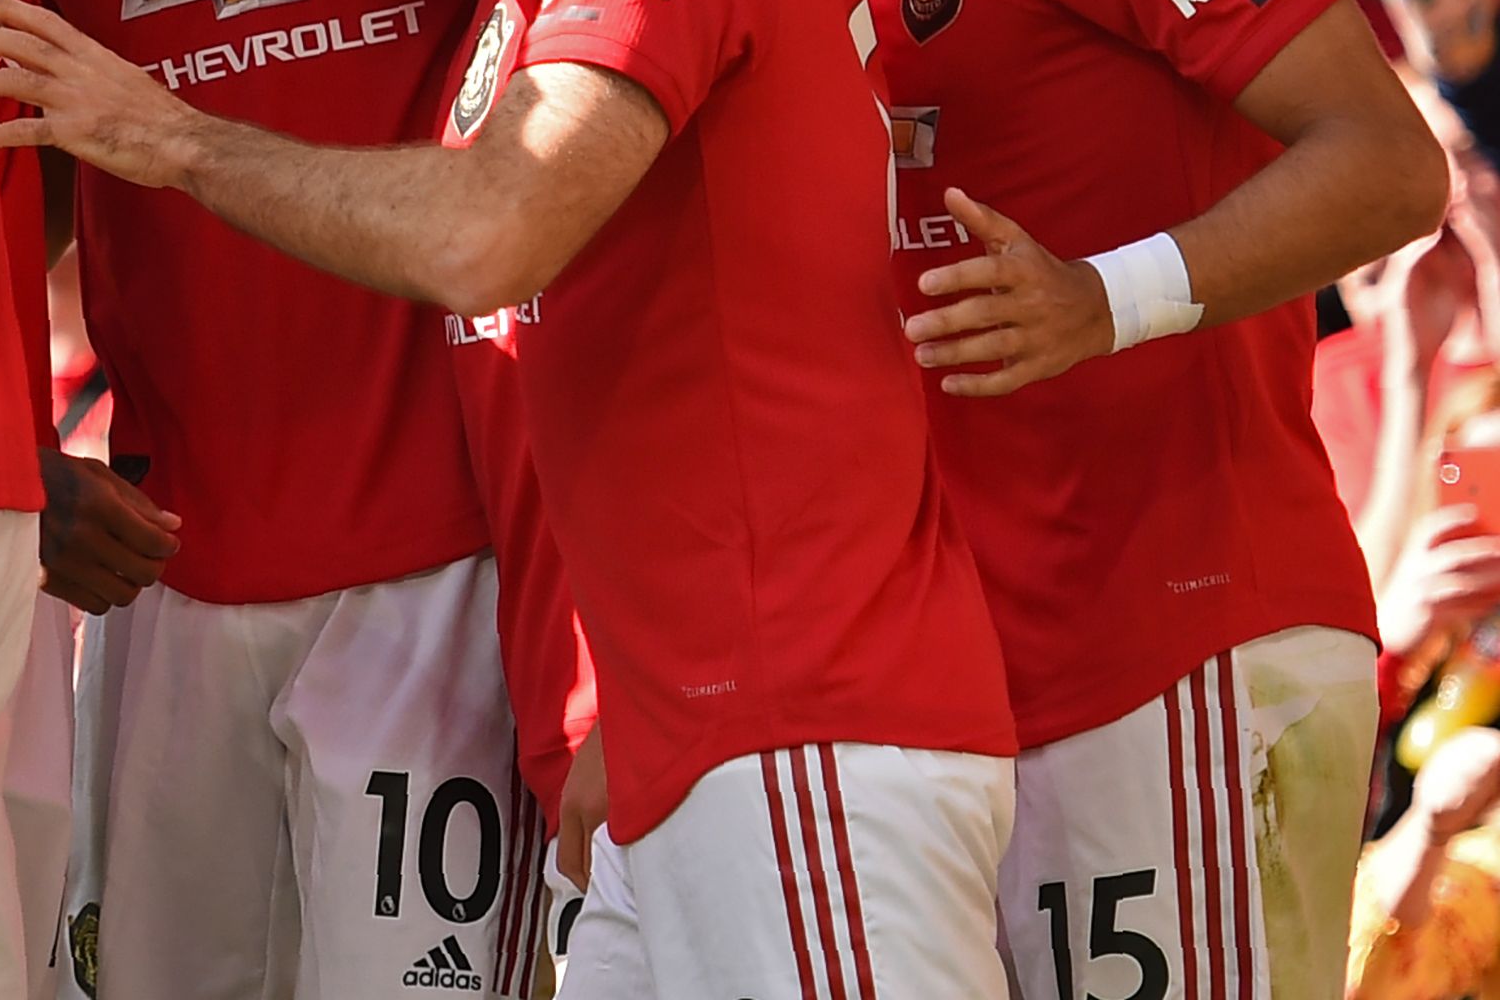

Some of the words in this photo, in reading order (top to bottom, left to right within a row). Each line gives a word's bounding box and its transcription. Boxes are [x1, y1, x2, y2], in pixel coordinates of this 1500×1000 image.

[140, 0, 426, 90] HEVROLET
[365, 770, 501, 924] 10
[402, 967, 483, 991] adidas
[1038, 868, 1169, 1000] 15
